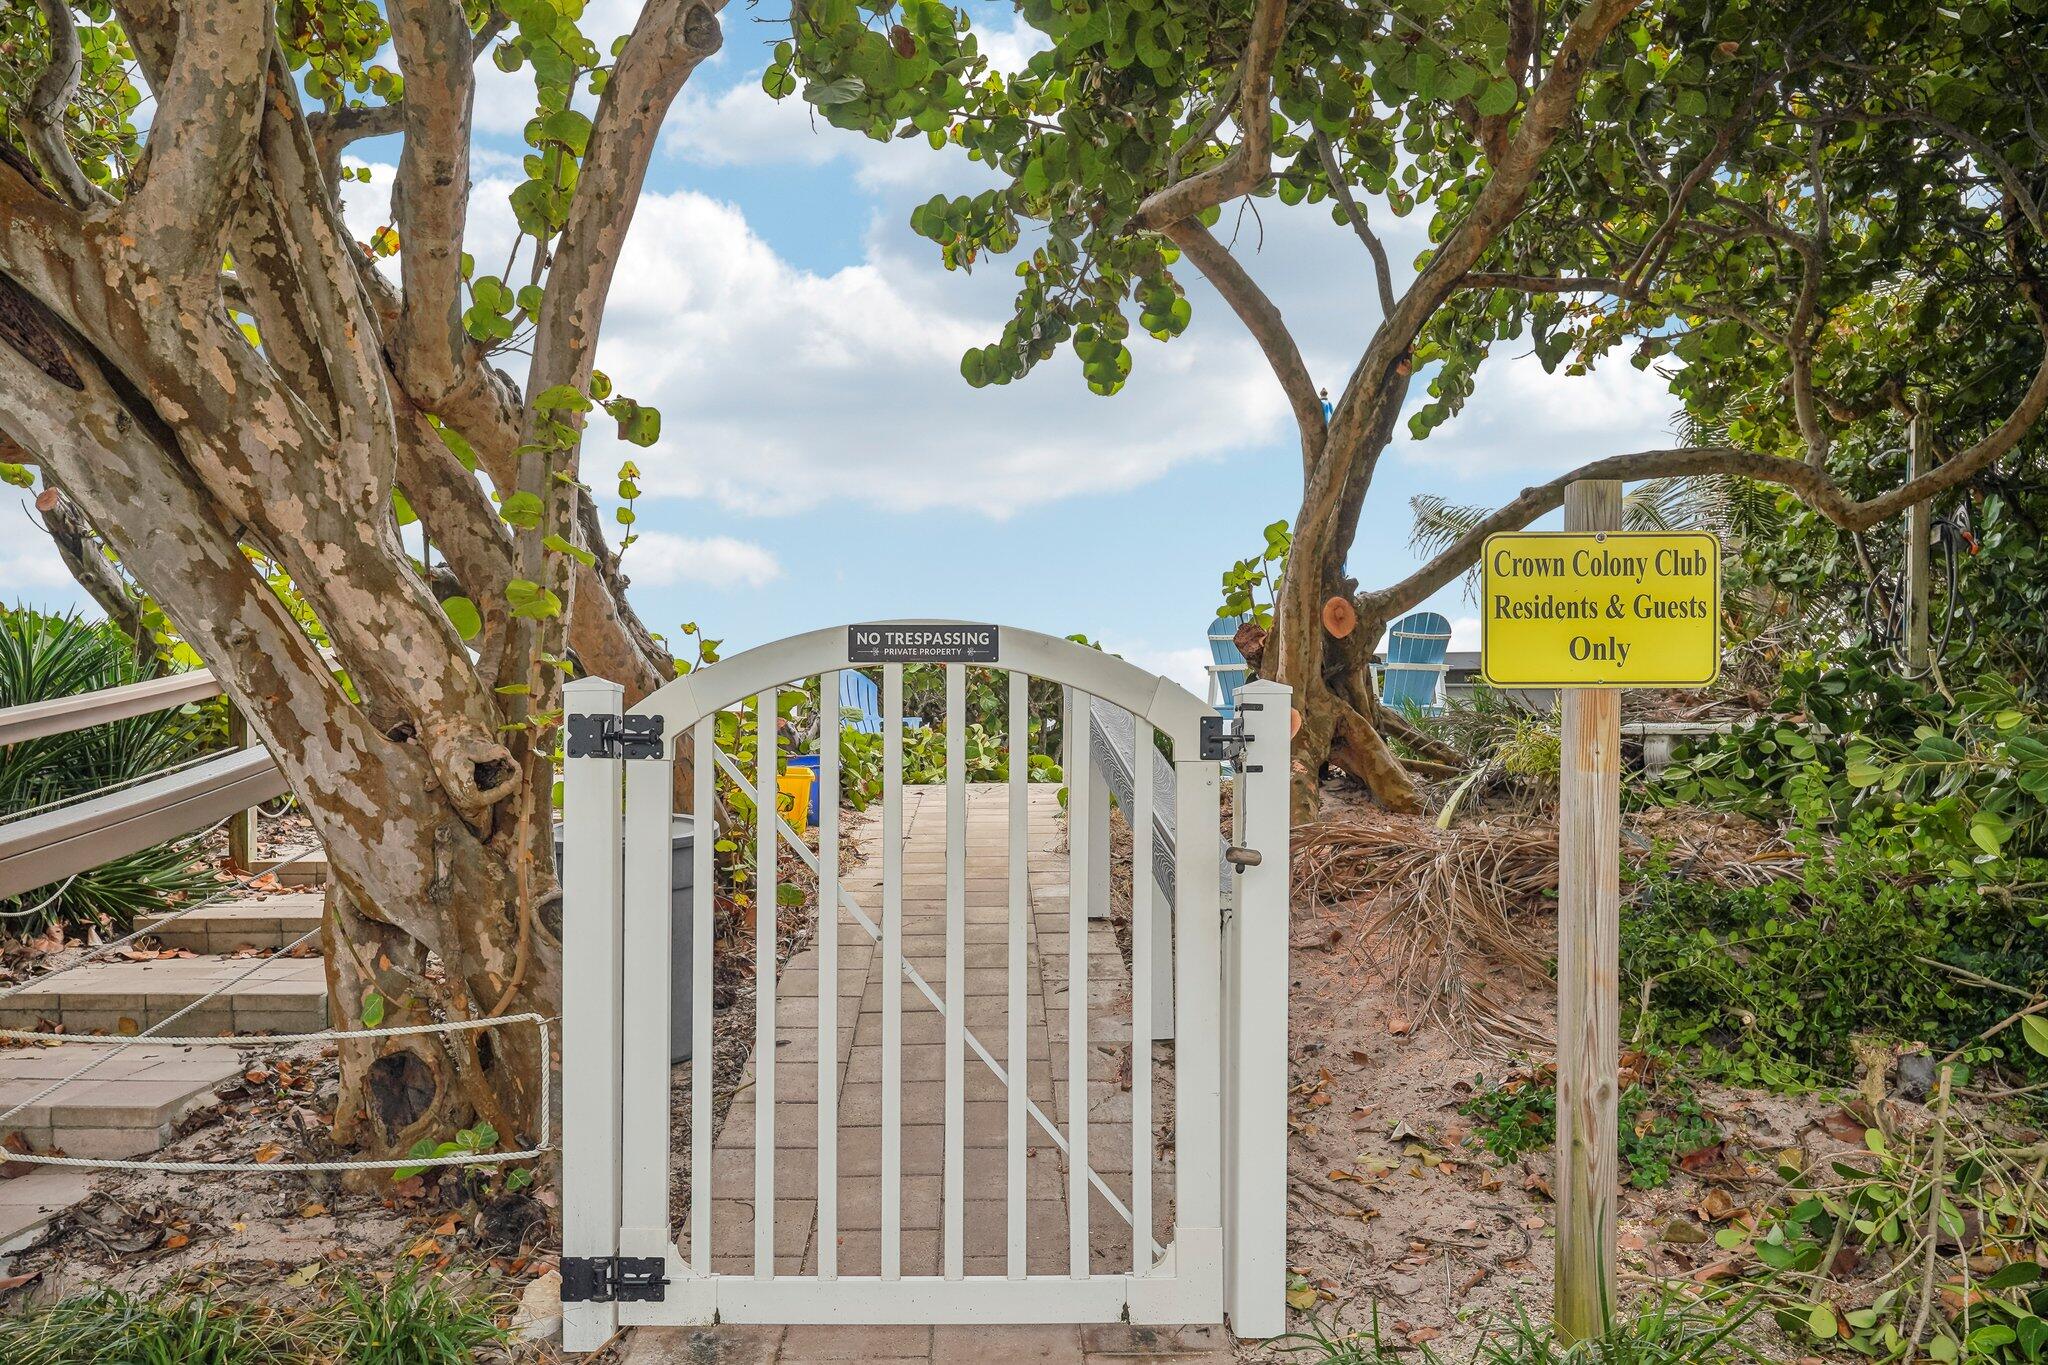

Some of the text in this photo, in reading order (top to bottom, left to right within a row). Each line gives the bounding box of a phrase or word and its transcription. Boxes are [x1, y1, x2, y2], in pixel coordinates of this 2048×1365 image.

[1494, 549, 1707, 584] Crown Colony Club
[1494, 594, 1707, 619] Residents & Guests
[856, 632, 990, 645] NO TRESPASSING
[884, 648, 962, 656] PRIVATE PROPERTY
[1569, 636, 1631, 667] Only
